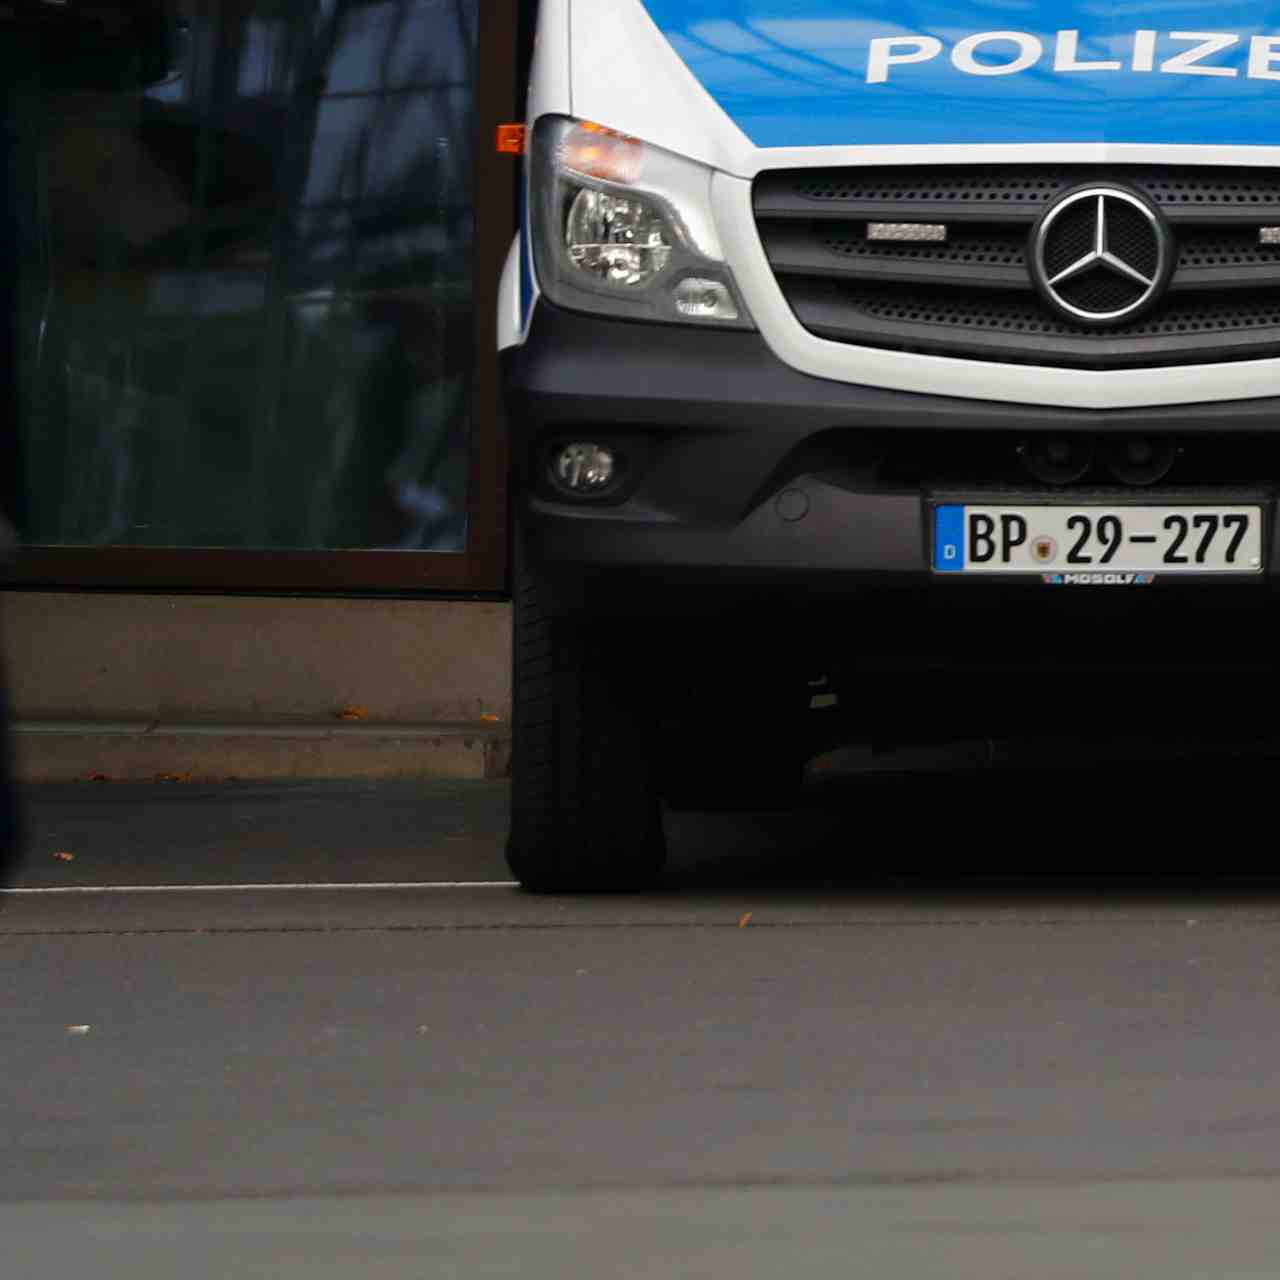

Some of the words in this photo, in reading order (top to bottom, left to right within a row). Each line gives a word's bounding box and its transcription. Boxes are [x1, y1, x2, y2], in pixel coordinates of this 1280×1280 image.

[943, 544, 957, 560] D
[967, 513, 1028, 564] BP
[1065, 513, 1250, 565] 29-277
